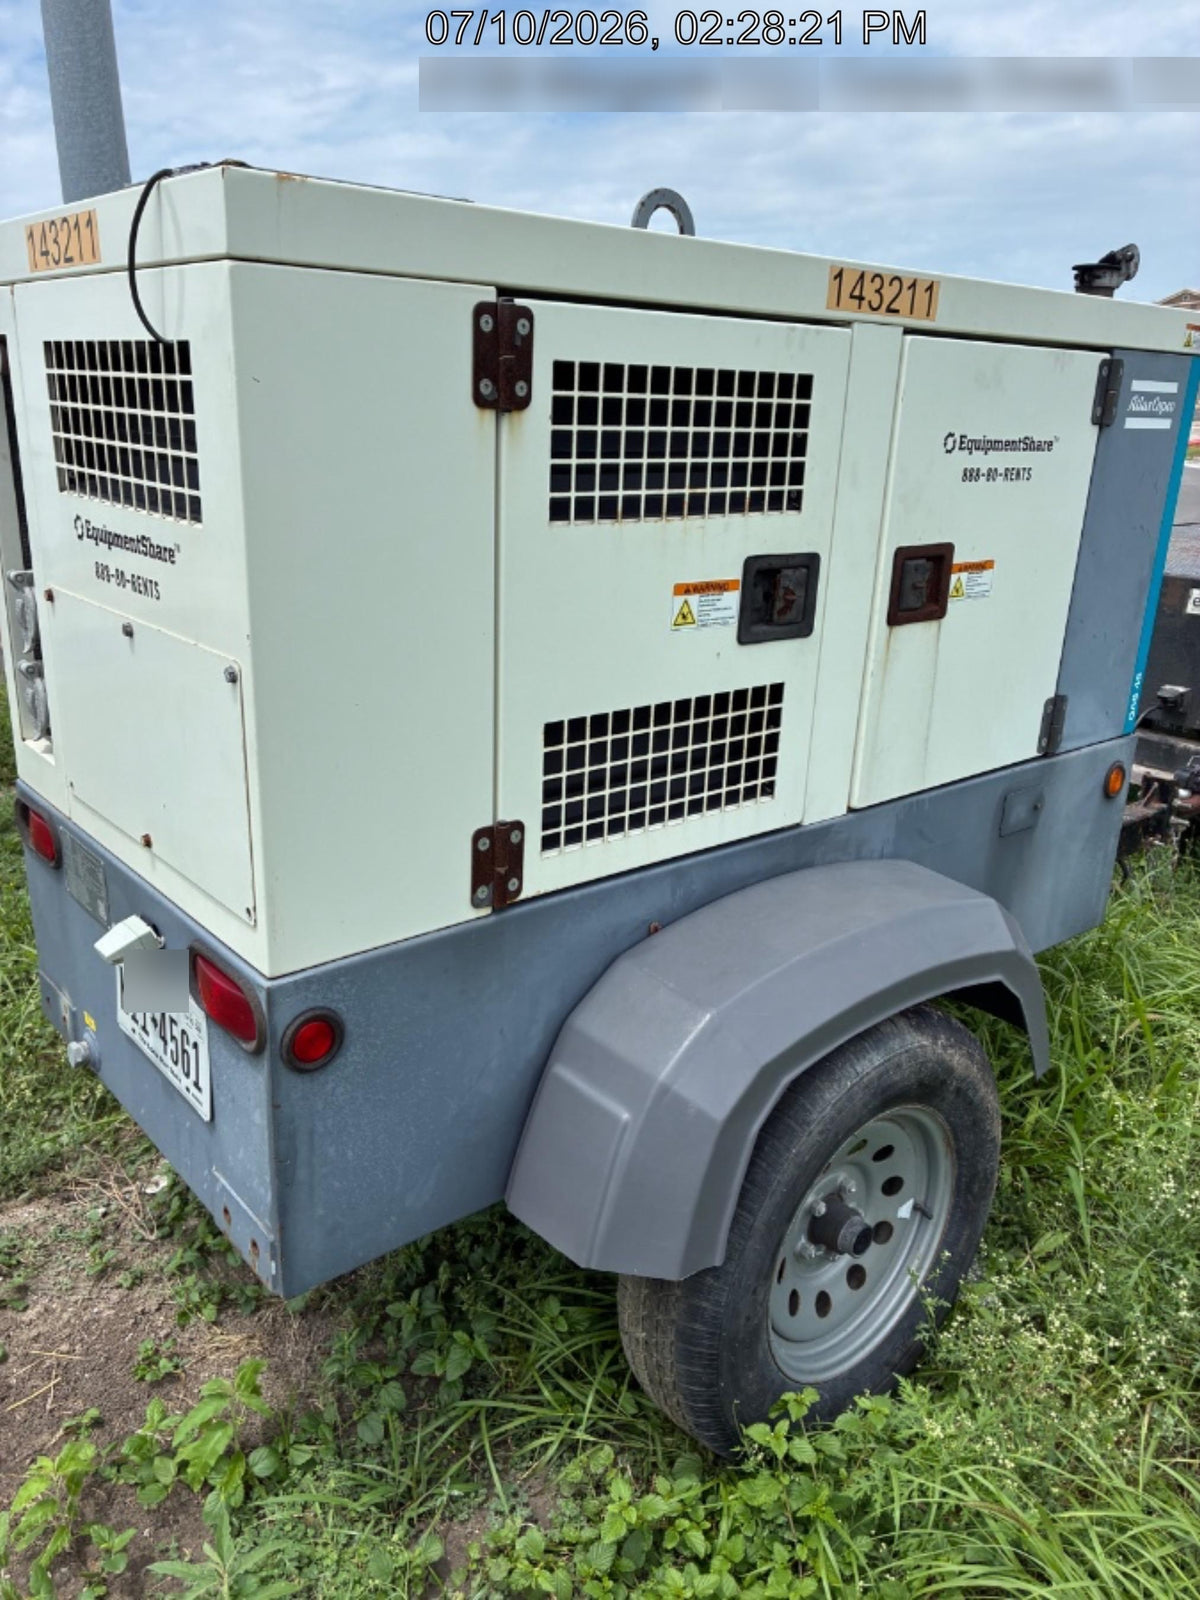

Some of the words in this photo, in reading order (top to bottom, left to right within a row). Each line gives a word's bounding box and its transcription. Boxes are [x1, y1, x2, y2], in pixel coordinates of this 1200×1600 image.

[28, 211, 97, 269] 143211
[833, 267, 935, 317] 143211
[958, 435, 1054, 456] EquipmentShare
[84, 519, 177, 565] EquipmentShare
